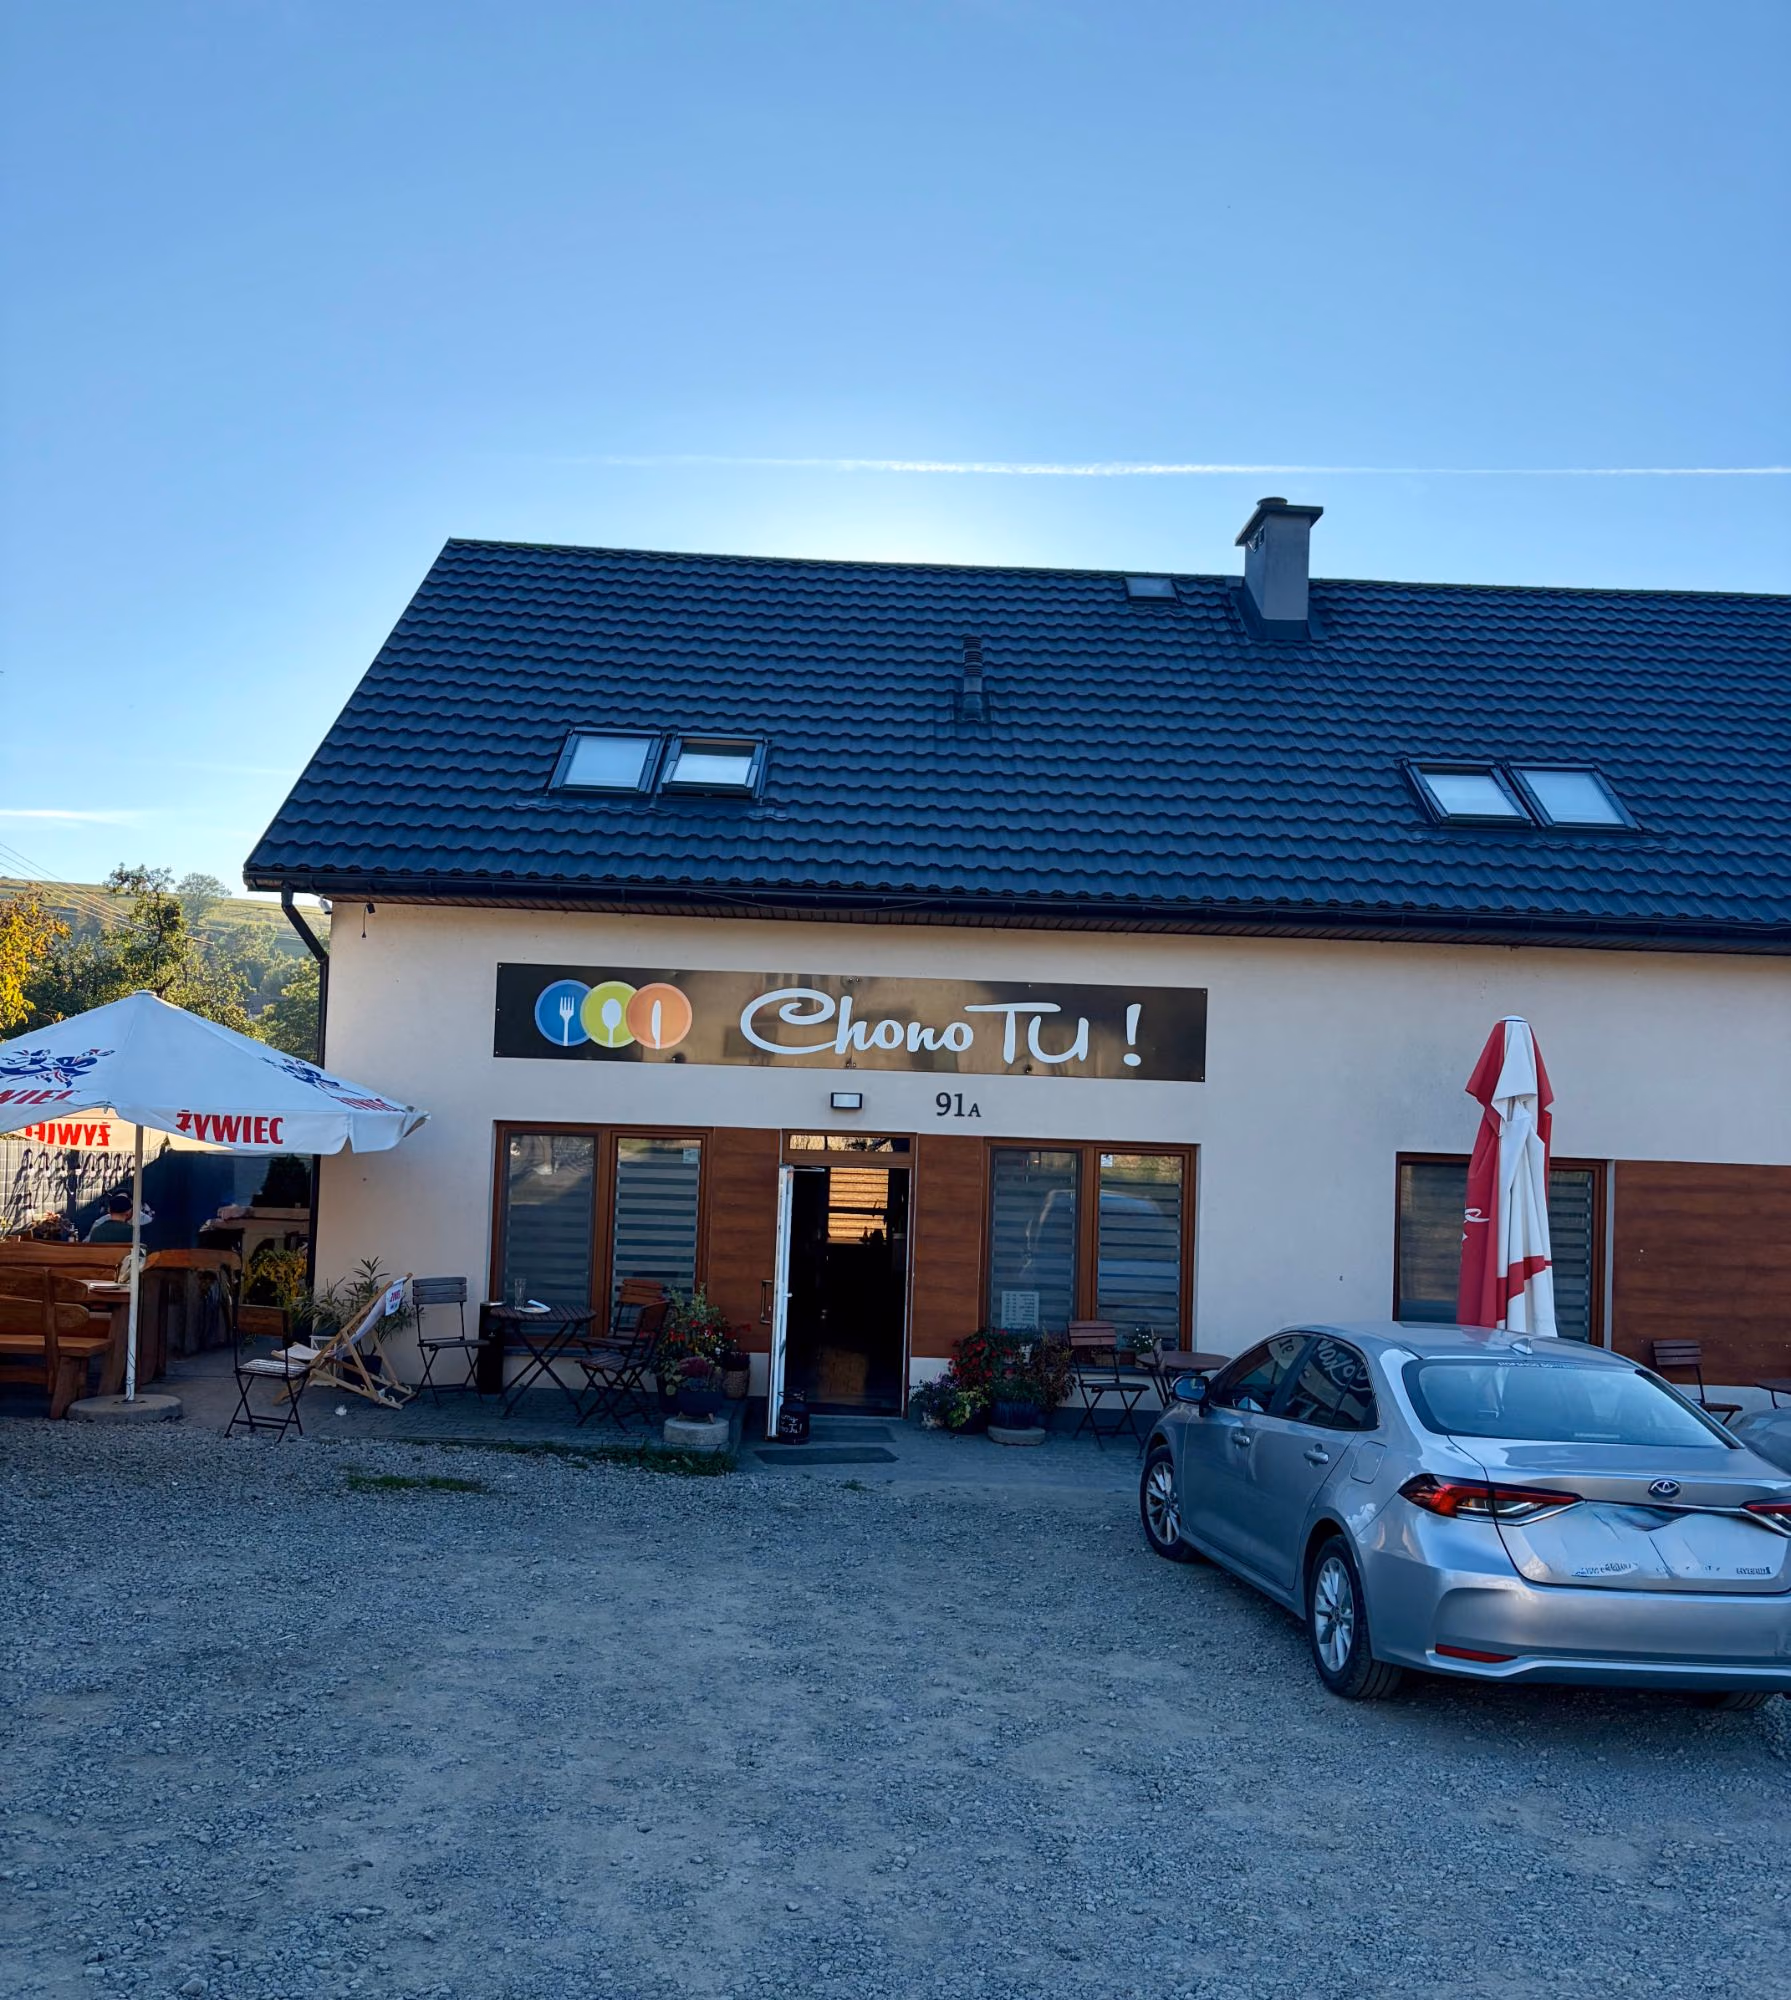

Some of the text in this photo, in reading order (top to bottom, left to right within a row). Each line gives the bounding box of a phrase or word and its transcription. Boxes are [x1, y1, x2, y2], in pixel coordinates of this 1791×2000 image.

[740, 988, 974, 1054] Chono
[936, 1092, 981, 1117] 91A
[176, 1109, 284, 1145] ŻYWIEC
